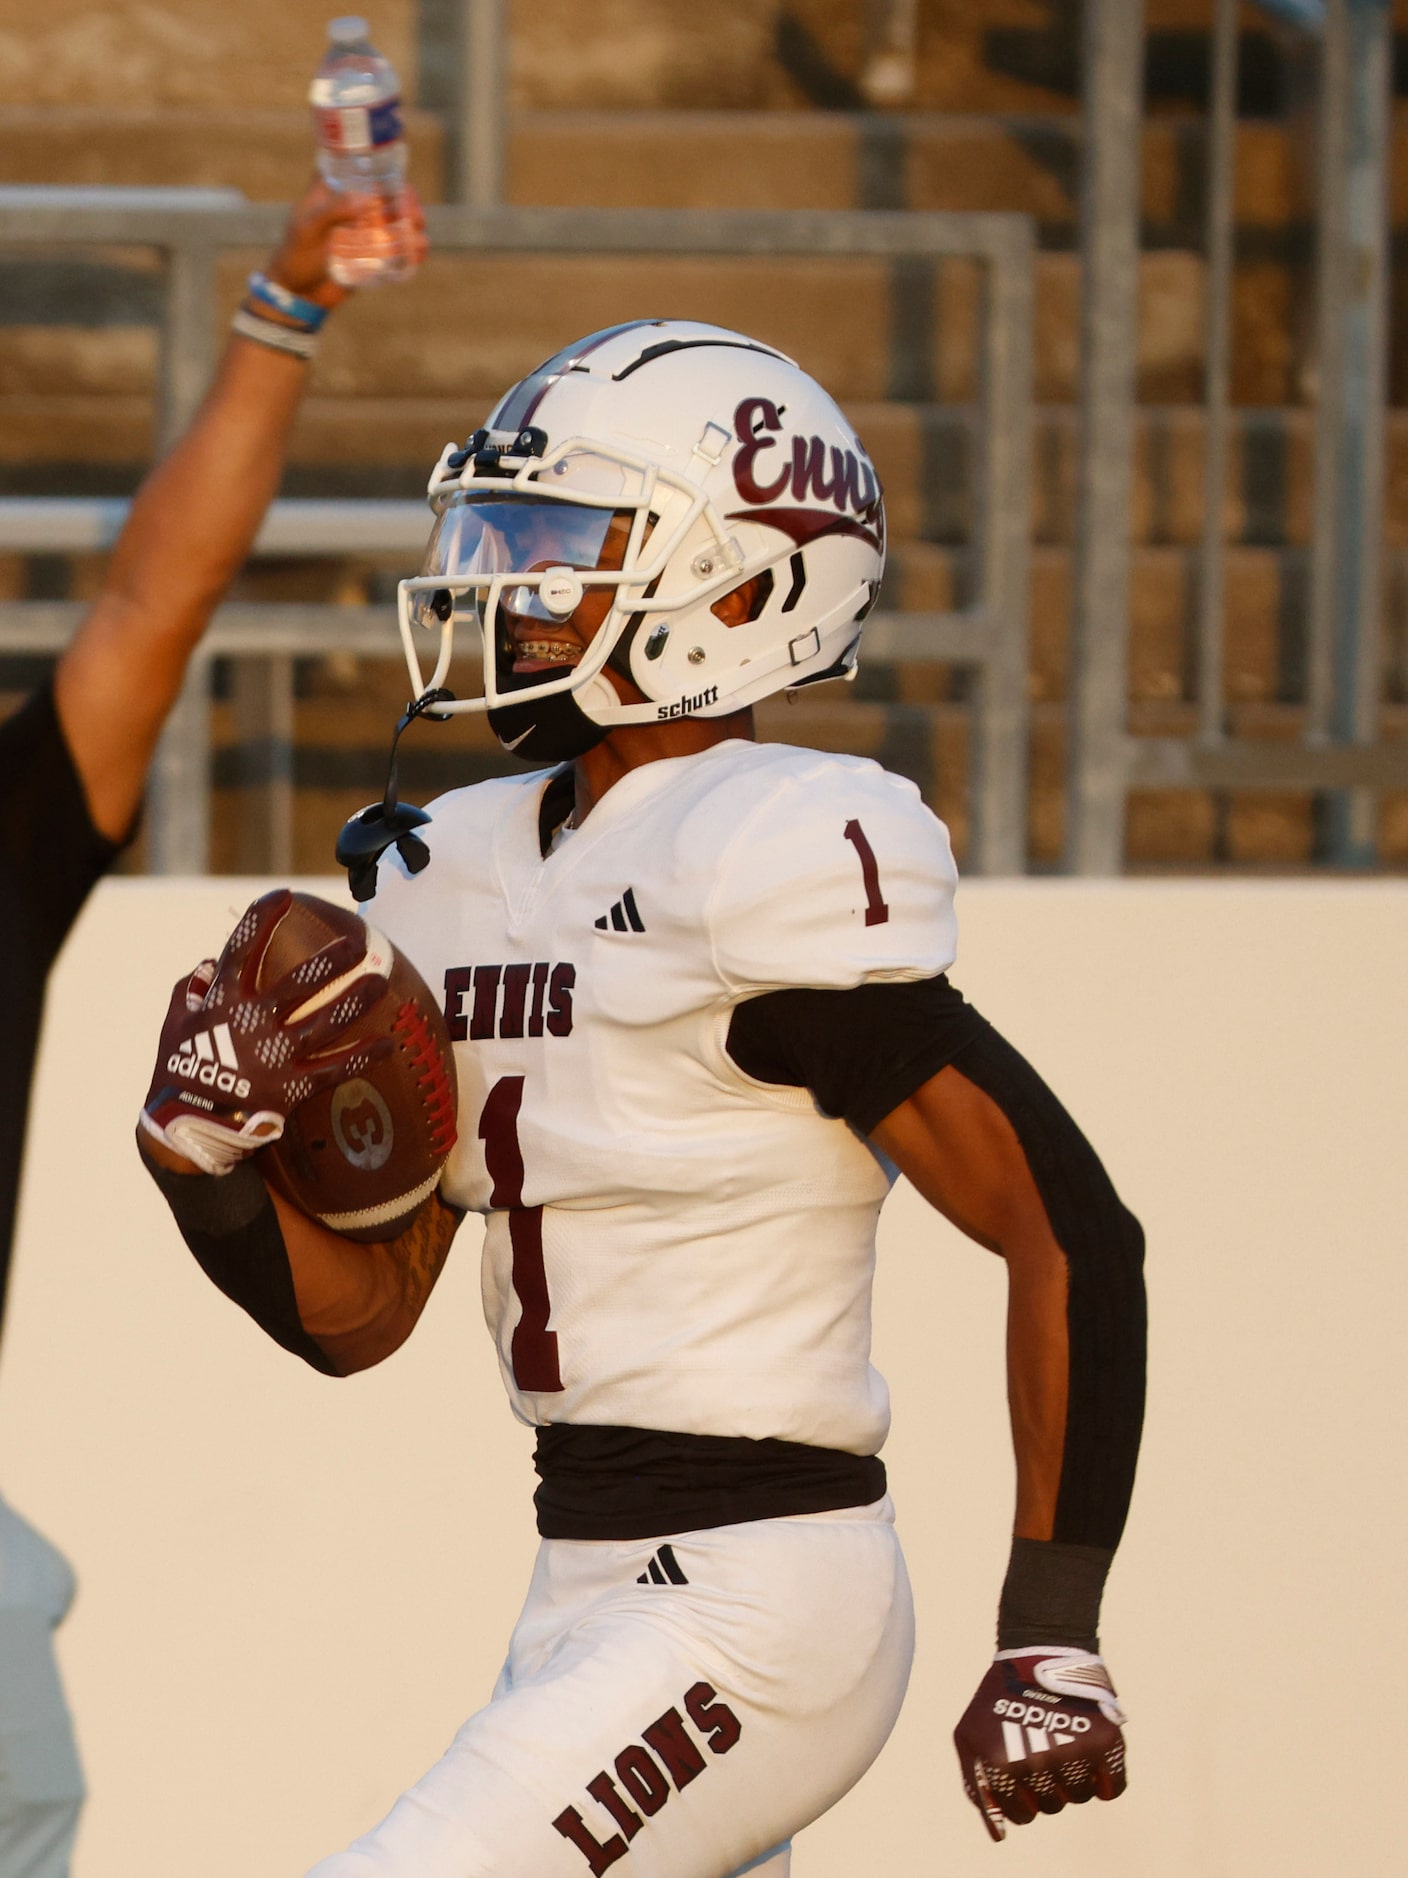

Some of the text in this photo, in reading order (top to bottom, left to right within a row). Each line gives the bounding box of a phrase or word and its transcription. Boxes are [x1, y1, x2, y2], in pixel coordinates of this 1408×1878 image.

[657, 684, 718, 719] schutt
[843, 818, 889, 927] 1
[444, 962, 577, 1042] ENNIS
[167, 1053, 252, 1099] adidas
[479, 1075, 566, 1392] 1
[992, 1698, 1092, 1734] adidas
[551, 1681, 742, 1878] LIONS
